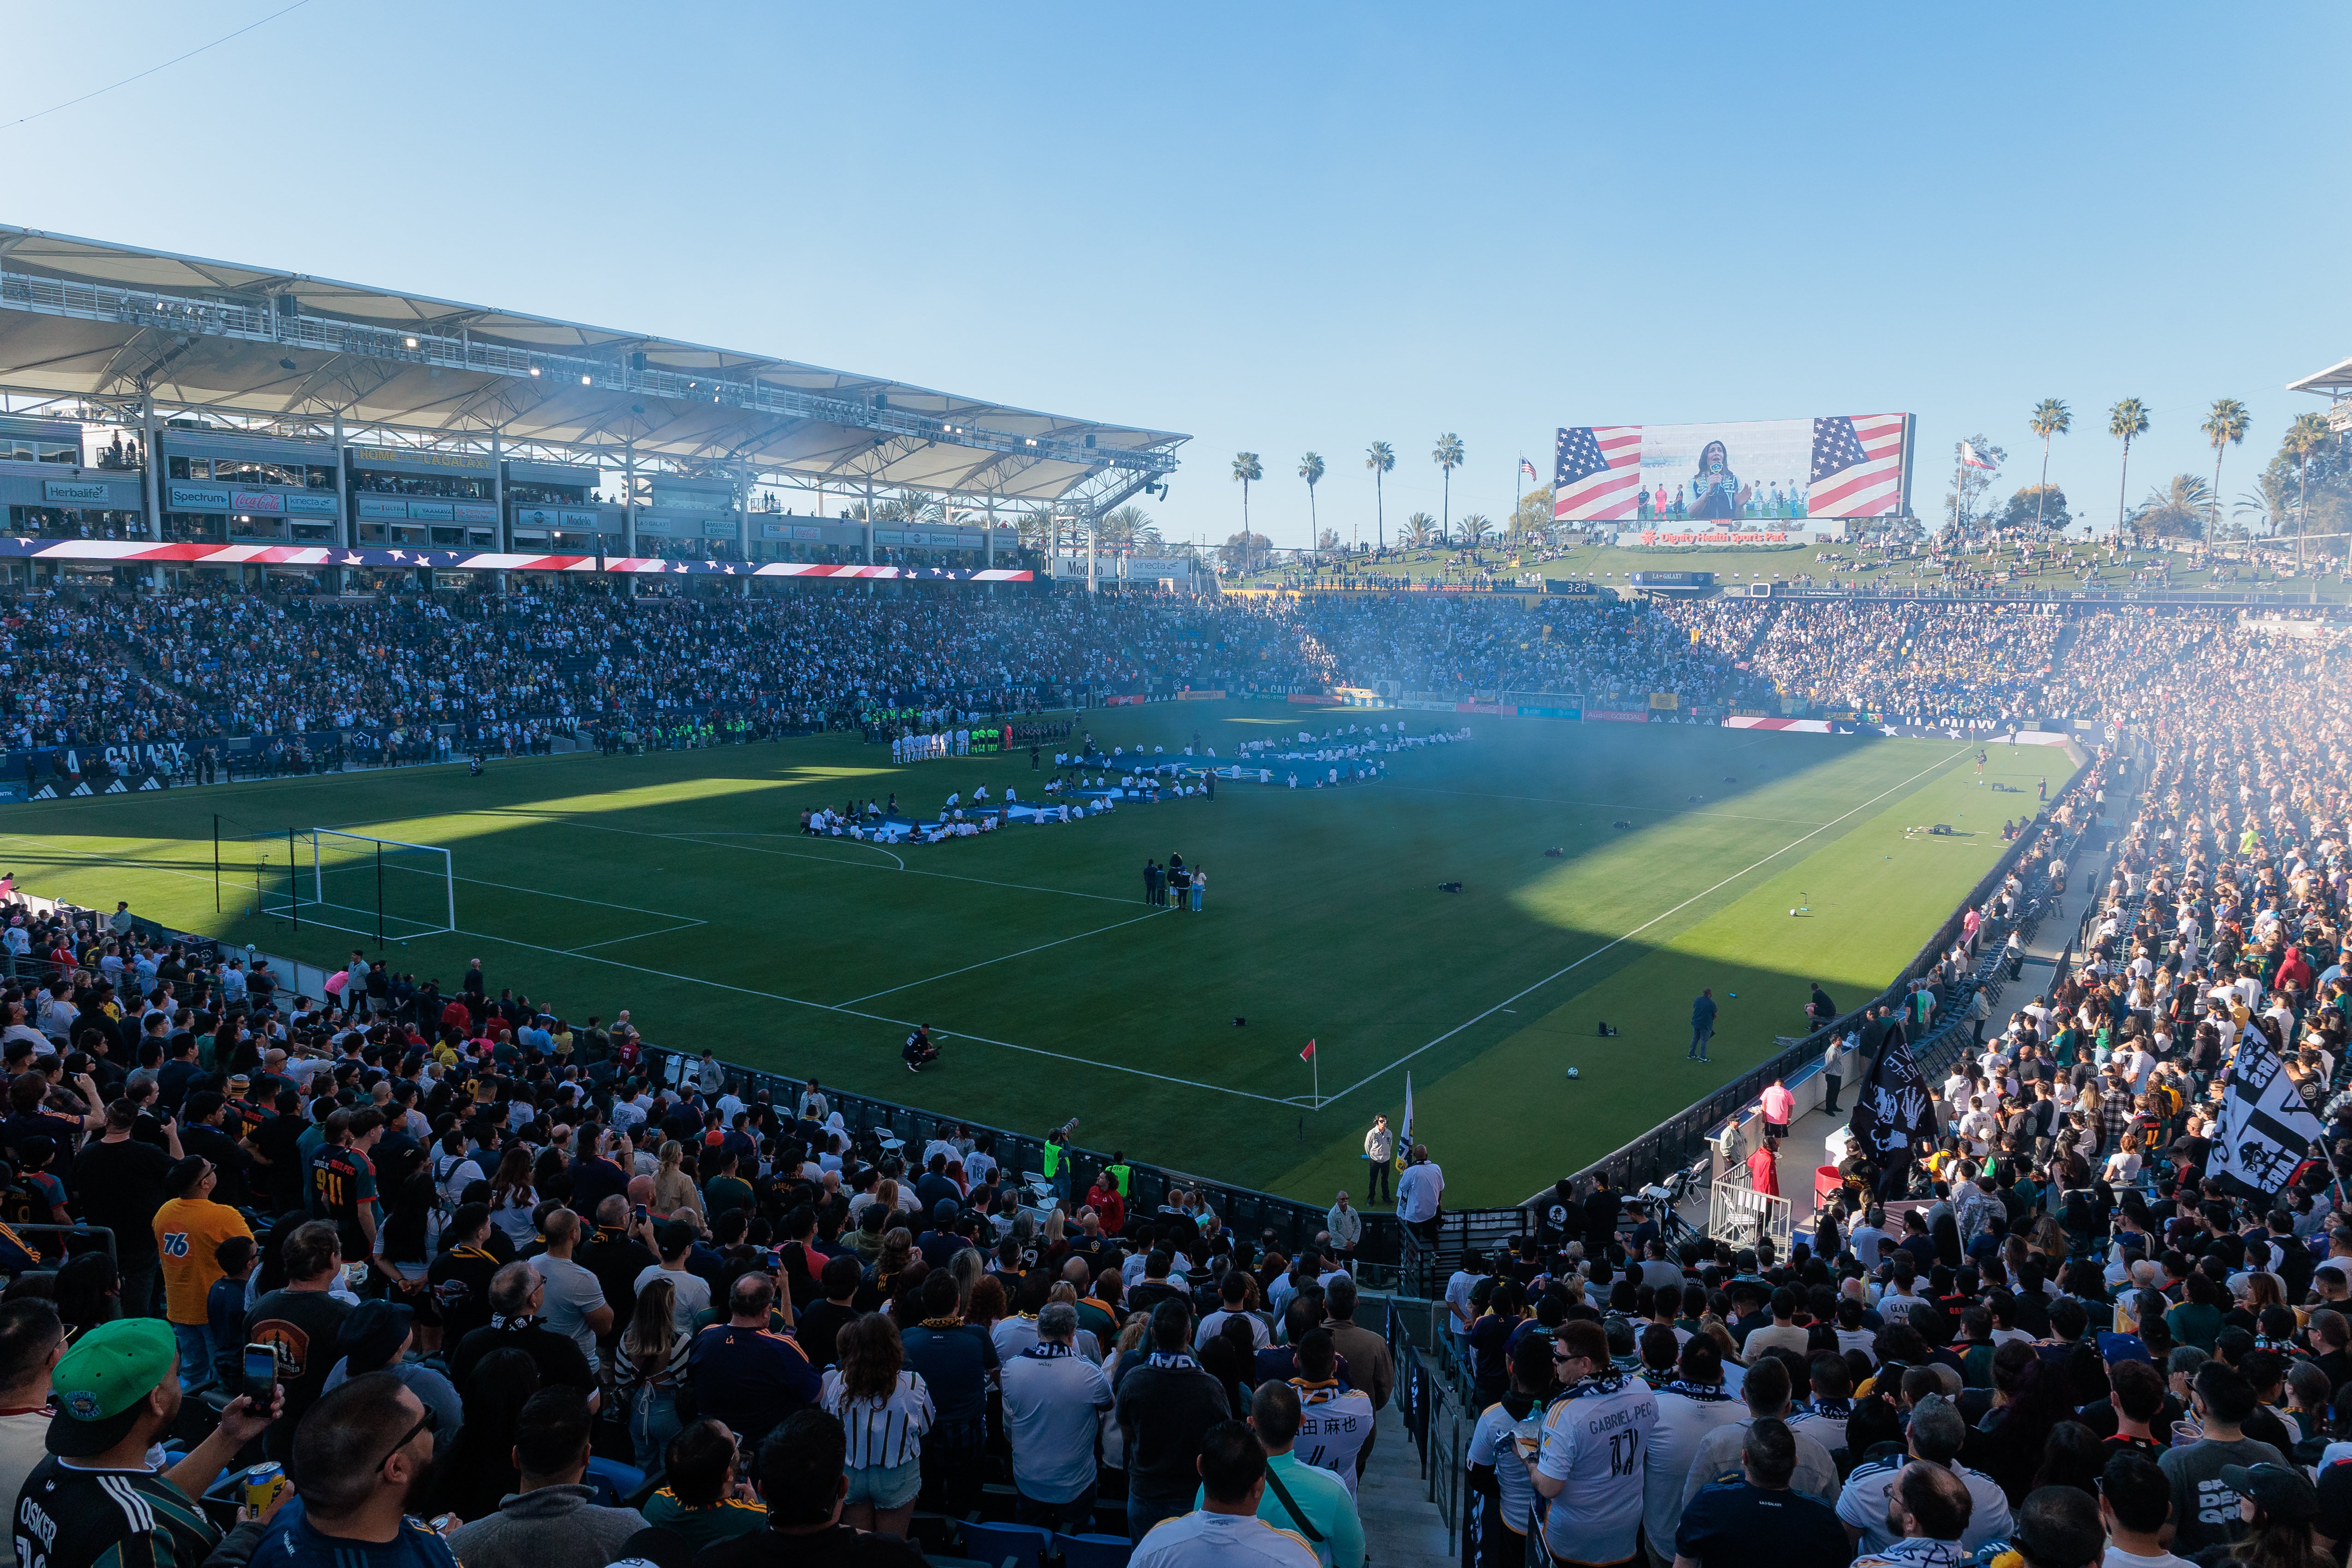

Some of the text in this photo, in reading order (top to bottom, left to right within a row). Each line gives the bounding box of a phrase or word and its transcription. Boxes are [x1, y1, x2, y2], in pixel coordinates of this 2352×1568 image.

[359, 449, 398, 461] HOME
[423, 454, 440, 465] LA
[441, 456, 491, 469] GALAXY
[50, 487, 100, 499] Herbalife
[174, 491, 224, 504] Spectrum
[290, 497, 320, 506] kinecta
[566, 515, 591, 526] Modelo
[1661, 532, 1787, 545] Dignity Health Sports Park
[1068, 561, 1103, 576] Modlo
[1134, 560, 1166, 570] kinecta
[1568, 583, 1587, 593] 3:20
[466, 1078, 479, 1101] 9
[2144, 1129, 2159, 1145] 11
[316, 1169, 326, 1190] 9
[971, 1165, 984, 1181] 18
[328, 1173, 344, 1206] 11
[163, 1231, 189, 1258] 76
[1023, 1248, 1038, 1268] 9
[1329, 1416, 1358, 1436] 麻也
[1589, 1402, 1652, 1435] GABRIEL PEC
[1609, 1427, 1639, 1477] 11
